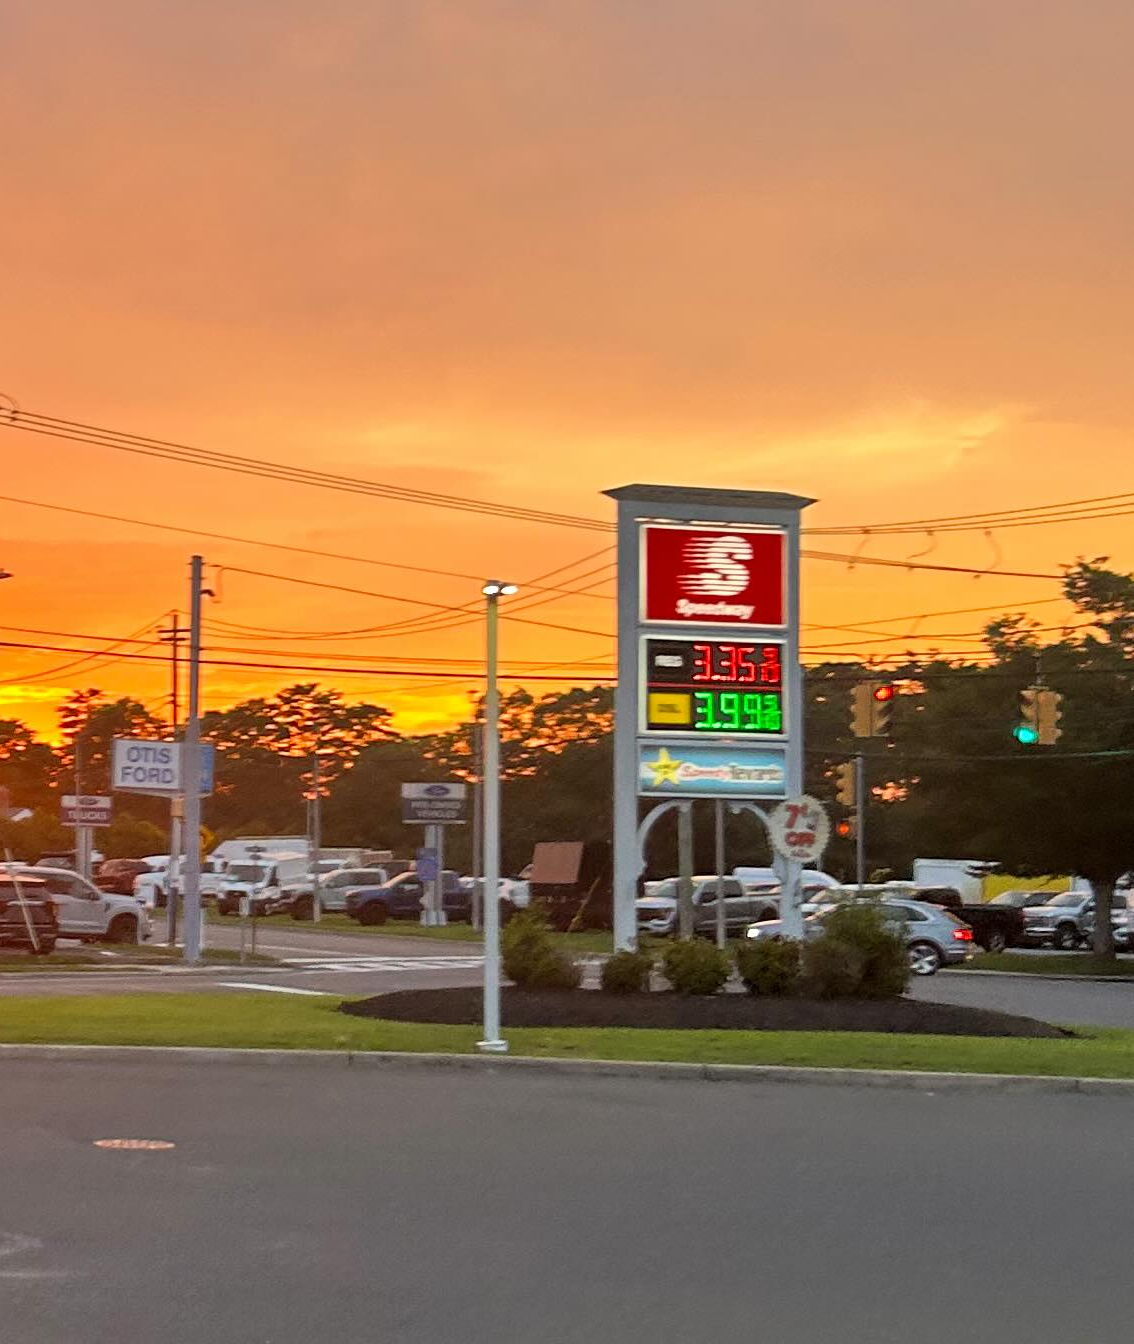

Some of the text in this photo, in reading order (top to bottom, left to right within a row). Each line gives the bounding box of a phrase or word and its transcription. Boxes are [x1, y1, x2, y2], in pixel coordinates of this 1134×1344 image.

[693, 645, 755, 681] 3.35
[694, 692, 761, 729] 3.99
[127, 746, 171, 764] OTIS
[121, 766, 174, 784] FORD
